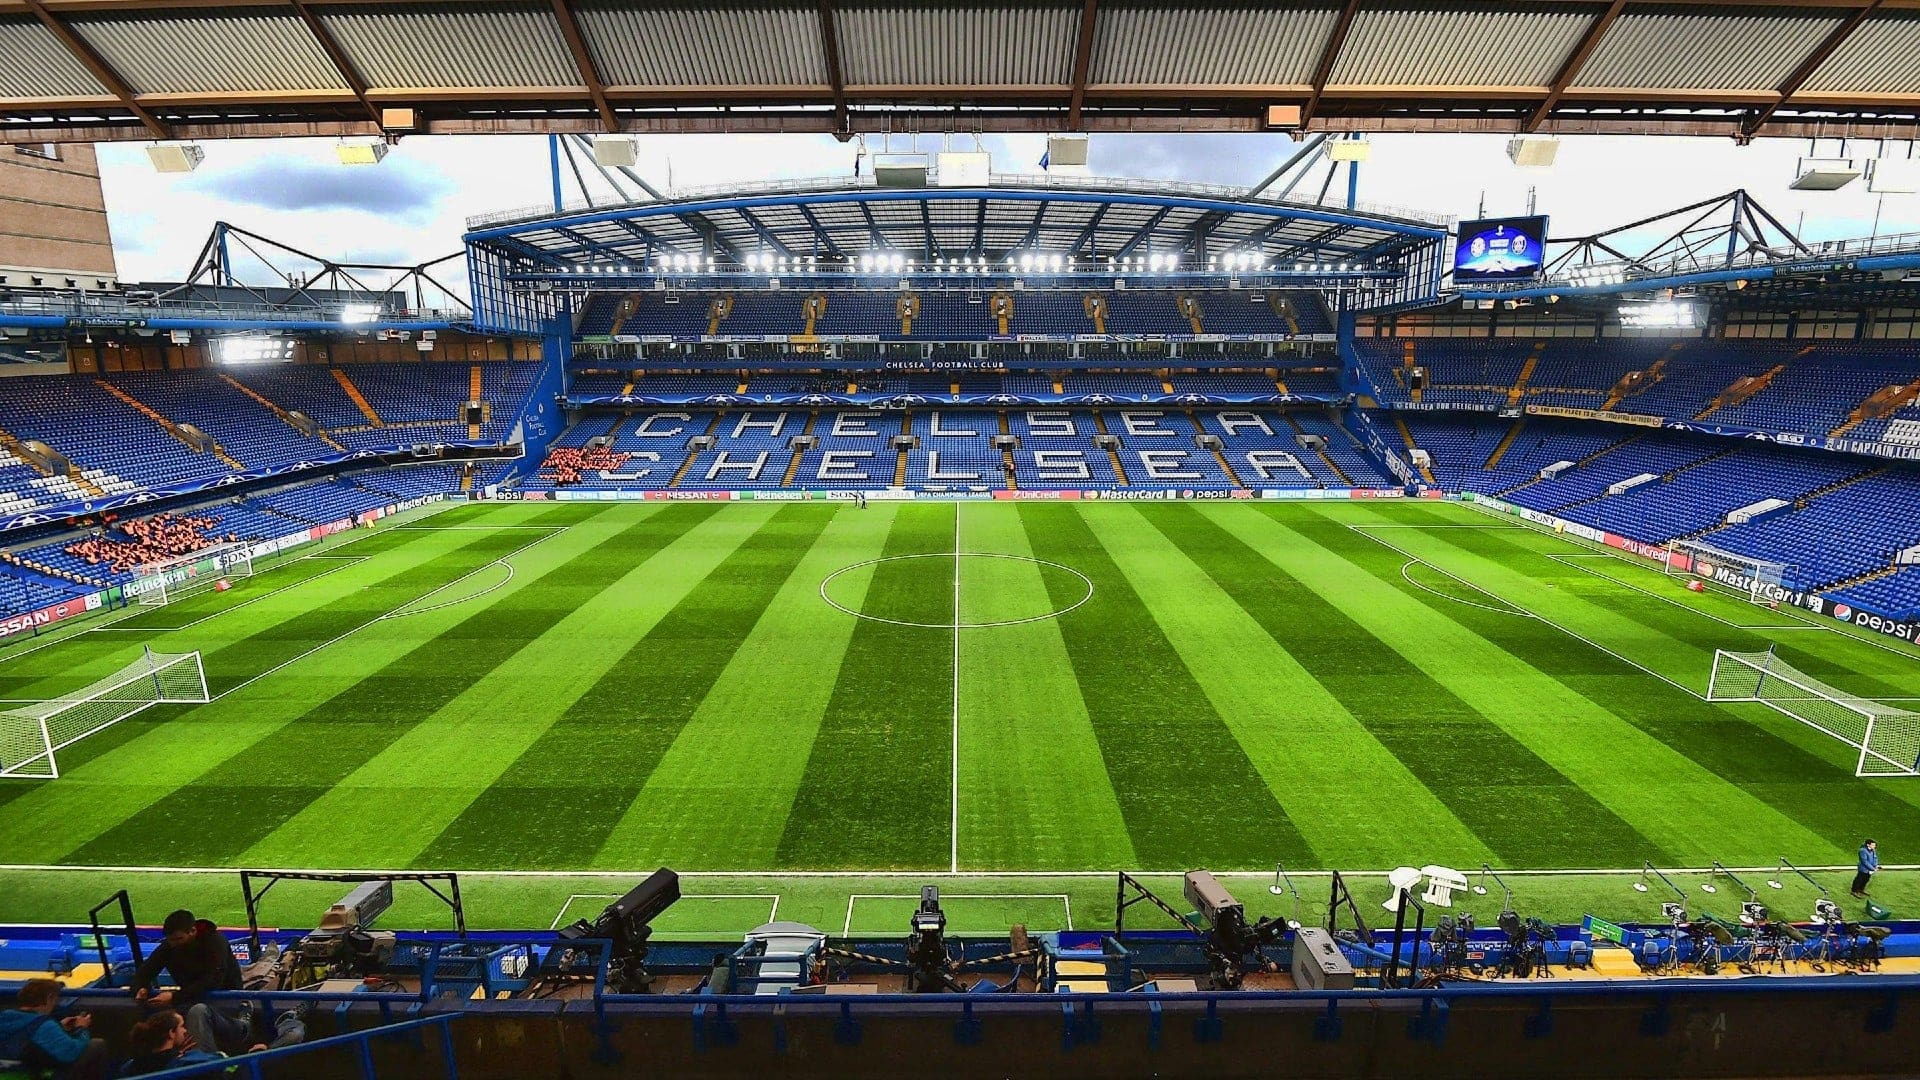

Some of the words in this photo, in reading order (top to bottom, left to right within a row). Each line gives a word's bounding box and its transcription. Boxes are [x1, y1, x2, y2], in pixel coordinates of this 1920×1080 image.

[886, 361, 925, 369] CHELSEA
[932, 361, 978, 369] FOOTBALL
[980, 361, 1004, 369] CLUB
[634, 411, 1275, 438] CHELSEA
[598, 450, 1313, 480] CHELSEA
[495, 490, 522, 501] epsi
[666, 491, 708, 499] NISSAN
[753, 491, 802, 500] Heineken
[1021, 490, 1060, 499] UniCredit
[1100, 490, 1164, 499] MasterCard
[1196, 489, 1228, 500] pepsi
[1373, 489, 1417, 498] NISSA
[396, 492, 444, 513] MasterCard
[1530, 511, 1557, 526] SONY
[218, 547, 256, 567] SONY
[121, 570, 187, 599] Heineken
[1855, 612, 1913, 640] pepsi
